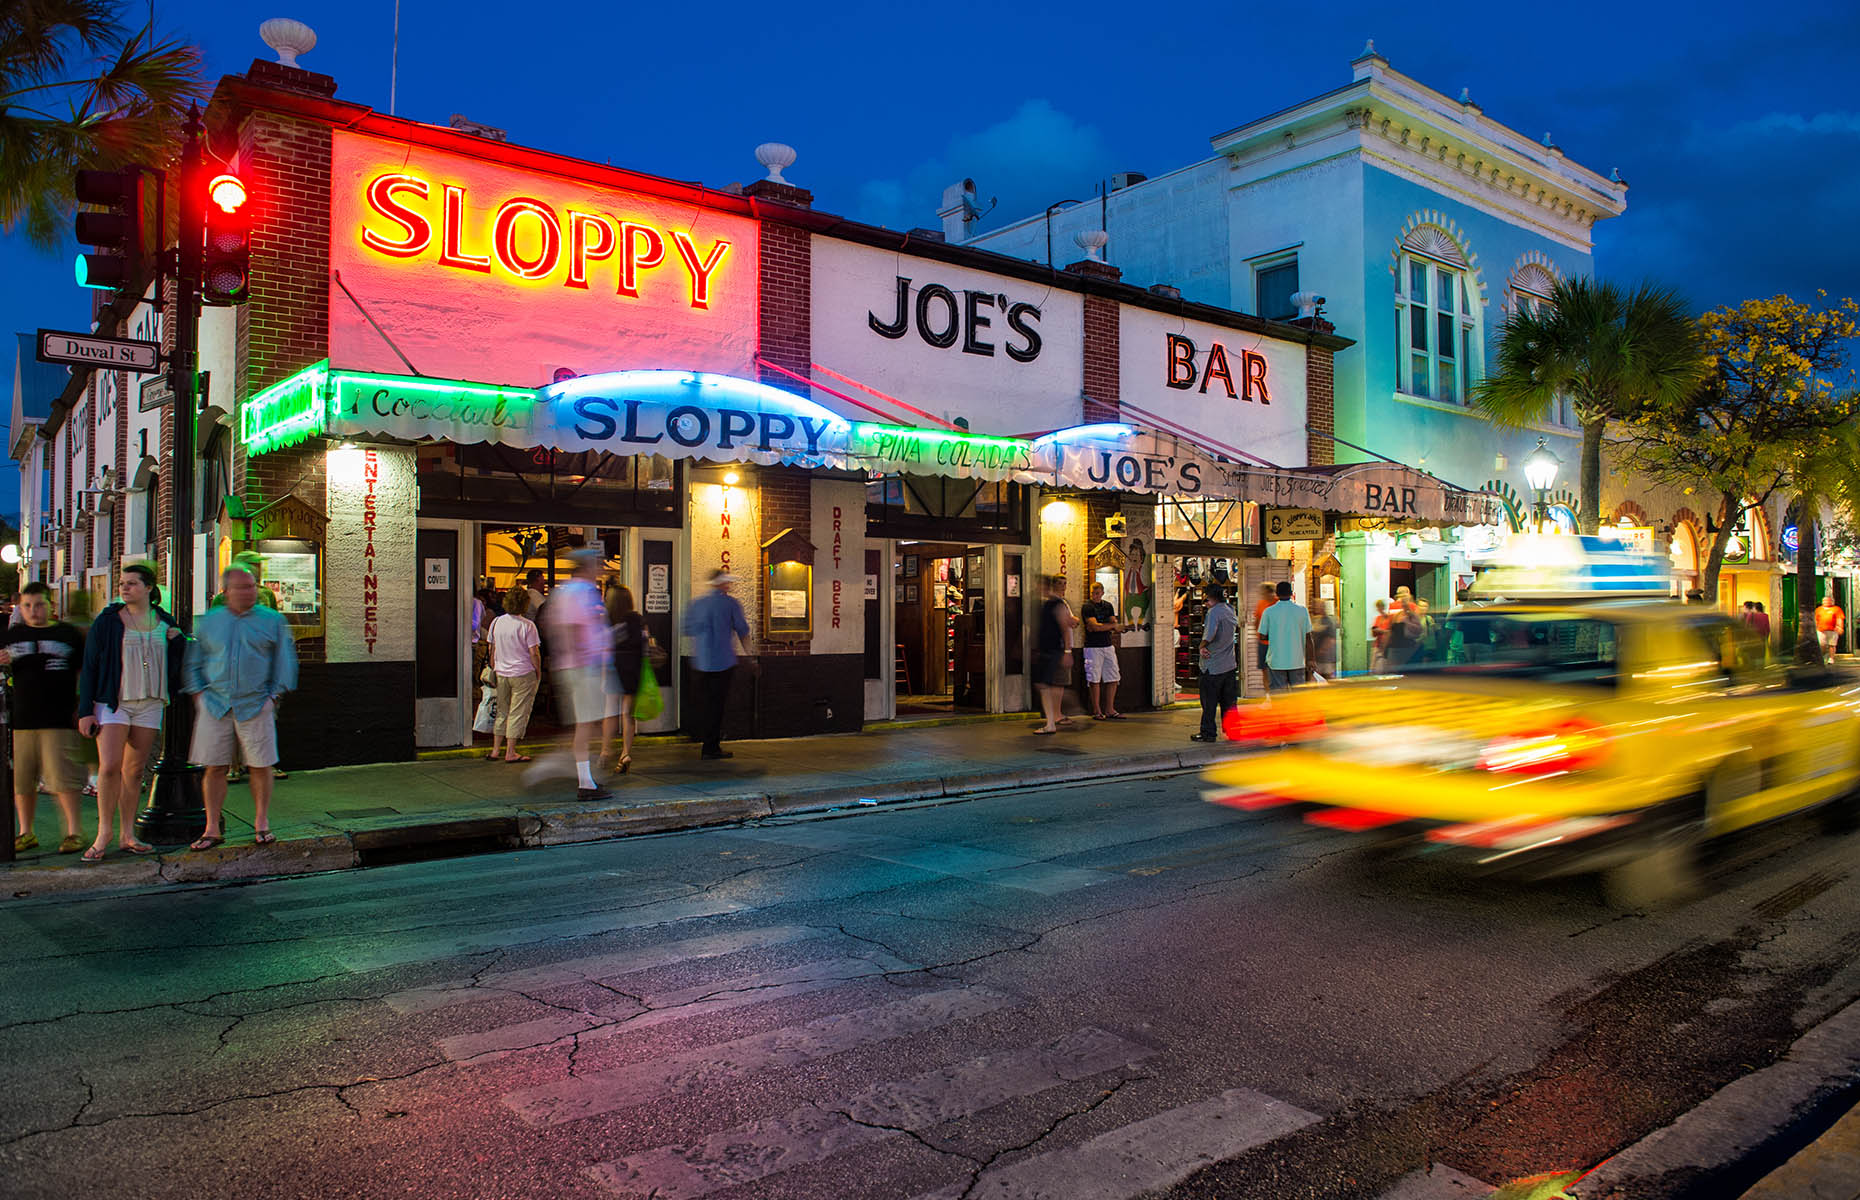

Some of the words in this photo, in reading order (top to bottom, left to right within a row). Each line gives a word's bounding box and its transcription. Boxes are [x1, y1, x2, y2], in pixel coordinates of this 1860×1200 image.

[362, 172, 732, 311] SLOPPY
[868, 275, 1043, 363] JOE'S
[66, 341, 114, 360] Duval
[119, 348, 136, 362] St
[1166, 332, 1272, 405] BAR
[97, 370, 119, 426] JOES
[372, 389, 519, 429] Cocktails
[574, 396, 832, 456] SLOPPY
[873, 431, 922, 464] PINA
[1088, 452, 1201, 493] JOE'S
[1365, 484, 1416, 514] BAR
[256, 507, 296, 534] SLOPPY
[296, 507, 323, 535] JOE'S
[832, 506, 842, 569] DRAFT
[364, 447, 378, 655] ENTERTAINMENT
[432, 564, 442, 573] NO
[427, 575, 448, 585] COVER
[865, 587, 876, 595] OVER
[831, 580, 841, 629] BEER
